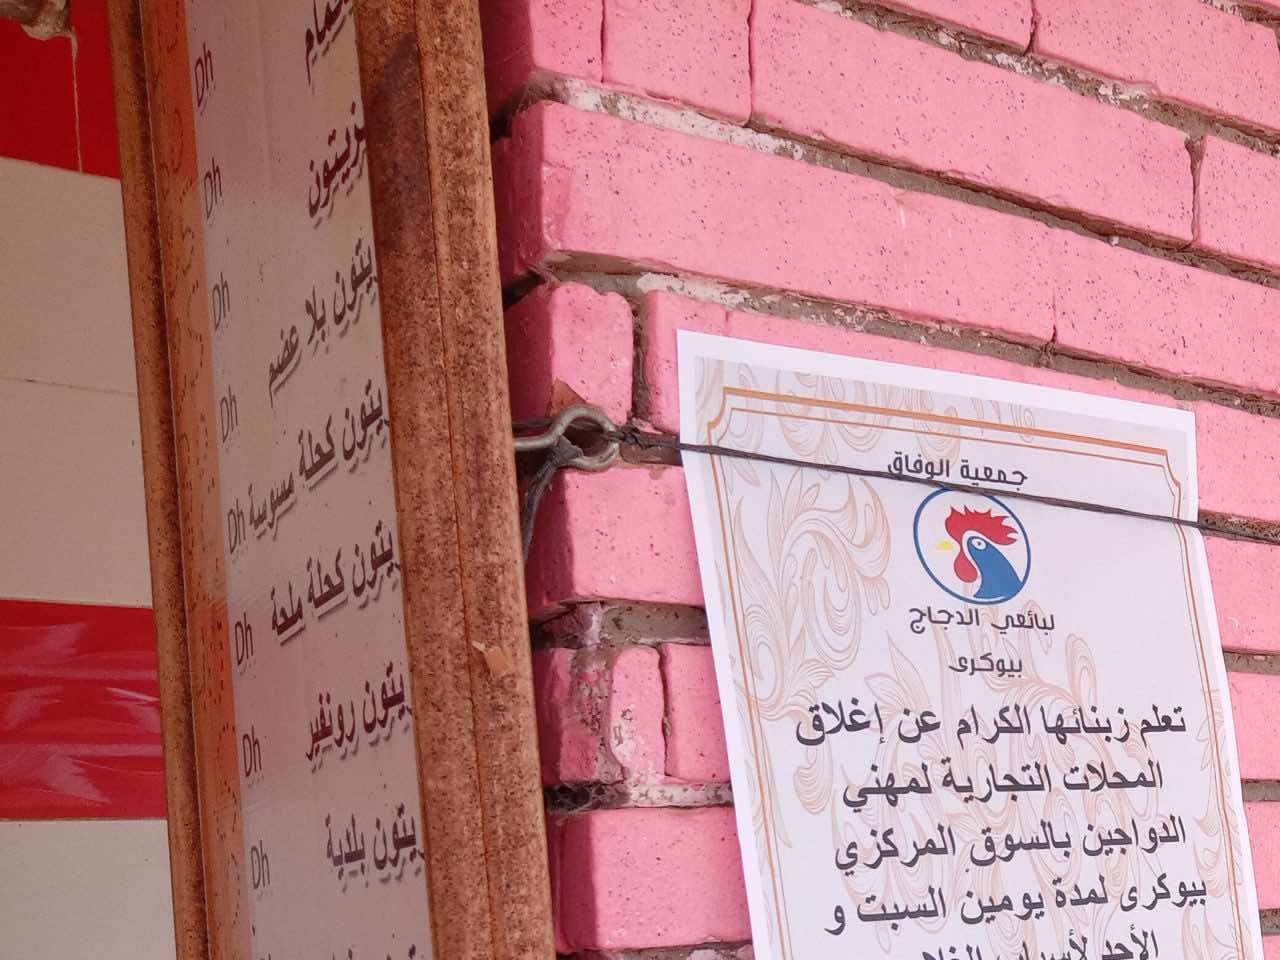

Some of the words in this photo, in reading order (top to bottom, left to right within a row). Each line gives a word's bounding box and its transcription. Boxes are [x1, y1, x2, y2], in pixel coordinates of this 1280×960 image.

[194, 41, 214, 108] Dh
[204, 156, 222, 220] Dh
[212, 272, 230, 331] Dh
[333, 238, 379, 325] يتون
[305, 285, 326, 345] بلا
[269, 325, 299, 408] عضم
[220, 384, 239, 443] Dh
[342, 379, 390, 461] يتون
[299, 414, 336, 481] كحلة
[887, 451, 950, 480] الوفاق
[960, 459, 1028, 491] جمعية
[227, 498, 245, 554] Dh
[307, 547, 345, 609] كحلة
[353, 520, 400, 597] يتون
[271, 581, 303, 636] ملحة
[909, 606, 980, 634] الدجاج
[991, 610, 1055, 636] لبائعي
[235, 611, 253, 666] Dh
[949, 653, 1023, 679] بيوكرى
[363, 662, 412, 733] يتون
[796, 697, 883, 746] إغلاق
[898, 707, 941, 743] عن
[956, 703, 1031, 749] الكرام
[1040, 704, 1130, 744] زبنائها
[1140, 704, 1186, 747] تعلم
[243, 725, 262, 777] Dh
[1063, 759, 1163, 790] المحلات
[843, 762, 932, 813] لمهني
[941, 757, 1053, 802] التجارية
[325, 813, 365, 880] بلدية
[374, 803, 424, 870] يتون
[835, 822, 956, 877] المركزي
[970, 818, 1072, 867] بالسوق
[1082, 814, 1186, 857] الدواجين
[250, 839, 270, 889] Dh
[856, 885, 947, 931] السبت
[960, 887, 1045, 924] يومين
[1055, 873, 1109, 908] لمدة
[1119, 873, 1207, 912] بيوكرى
[824, 903, 846, 936] و
